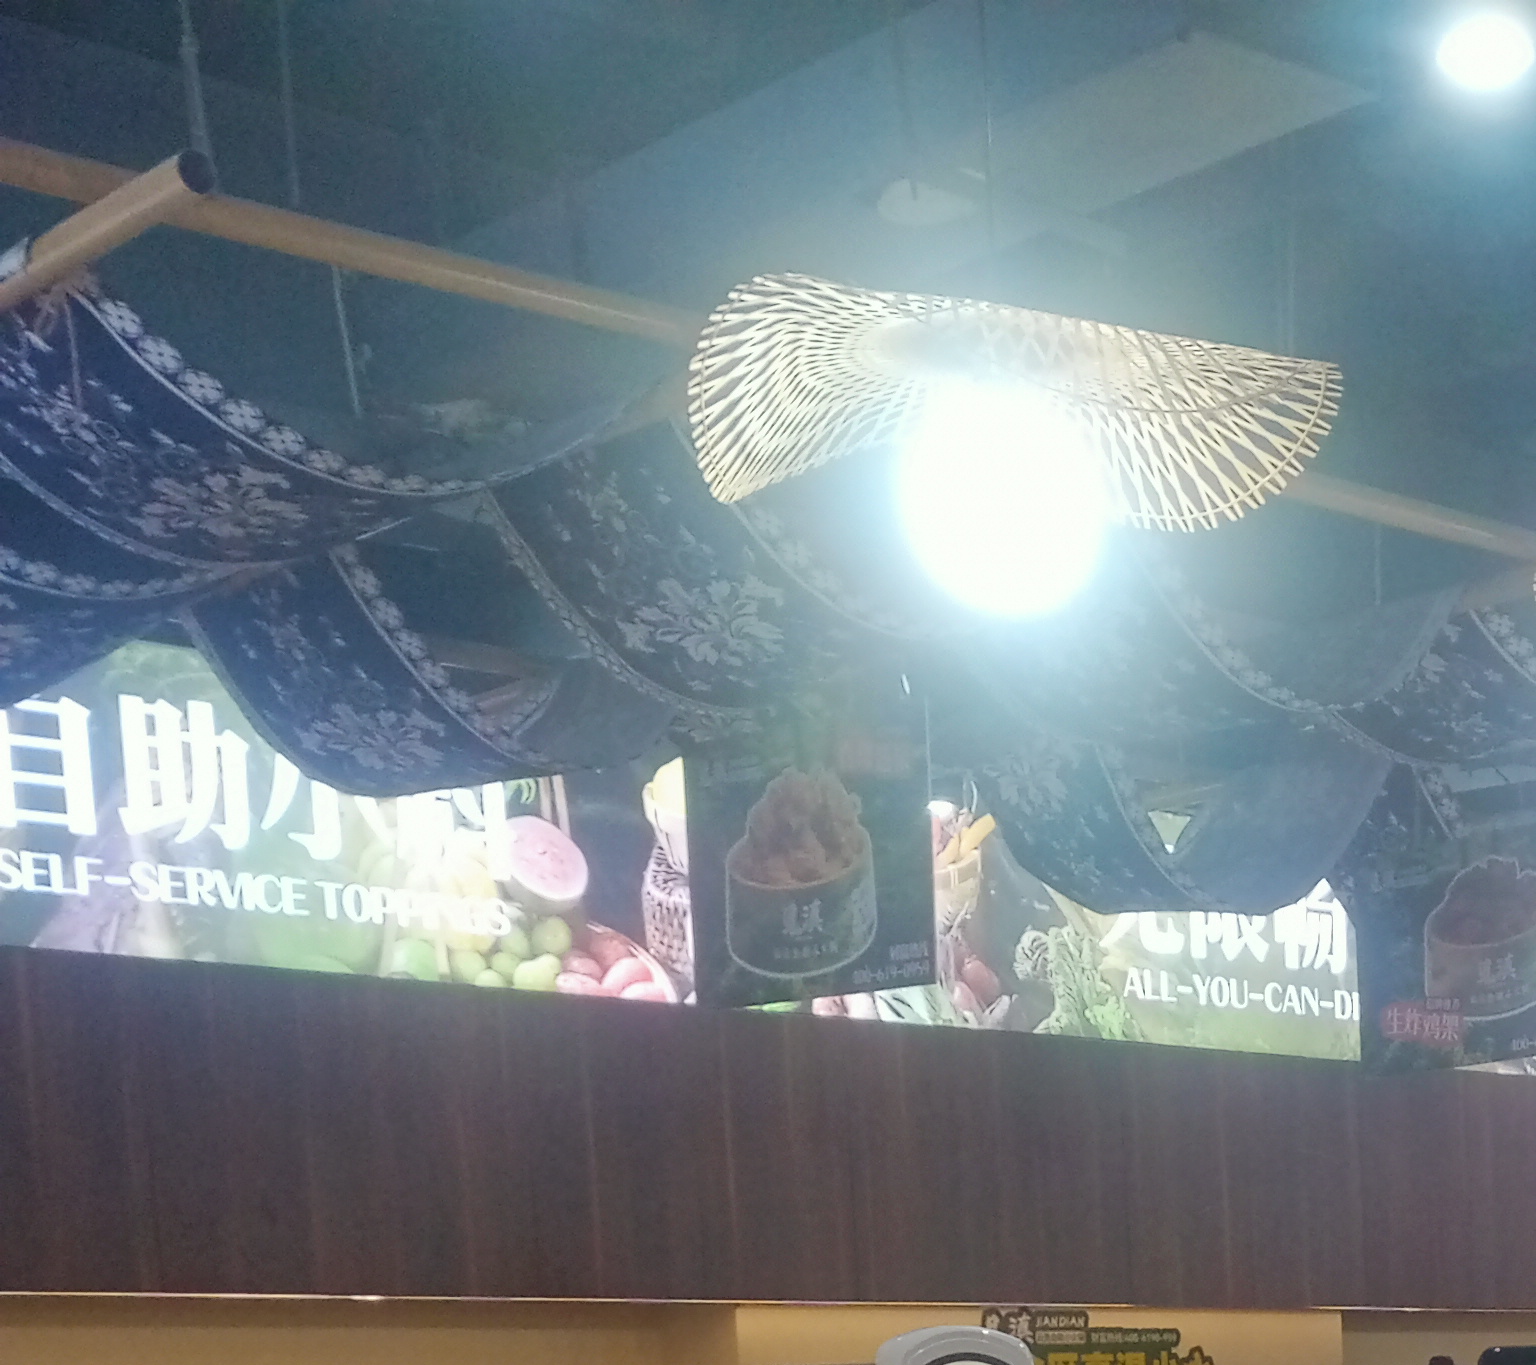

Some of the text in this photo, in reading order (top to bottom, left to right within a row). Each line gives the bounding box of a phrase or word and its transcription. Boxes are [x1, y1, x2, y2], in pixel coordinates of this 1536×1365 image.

[0, 851, 512, 937] SELF-SERVICE TOPPINGS
[1387, 1007, 1460, 1041] 生炸鸡架
[1036, 1315, 1086, 1328] JIANDIAN
